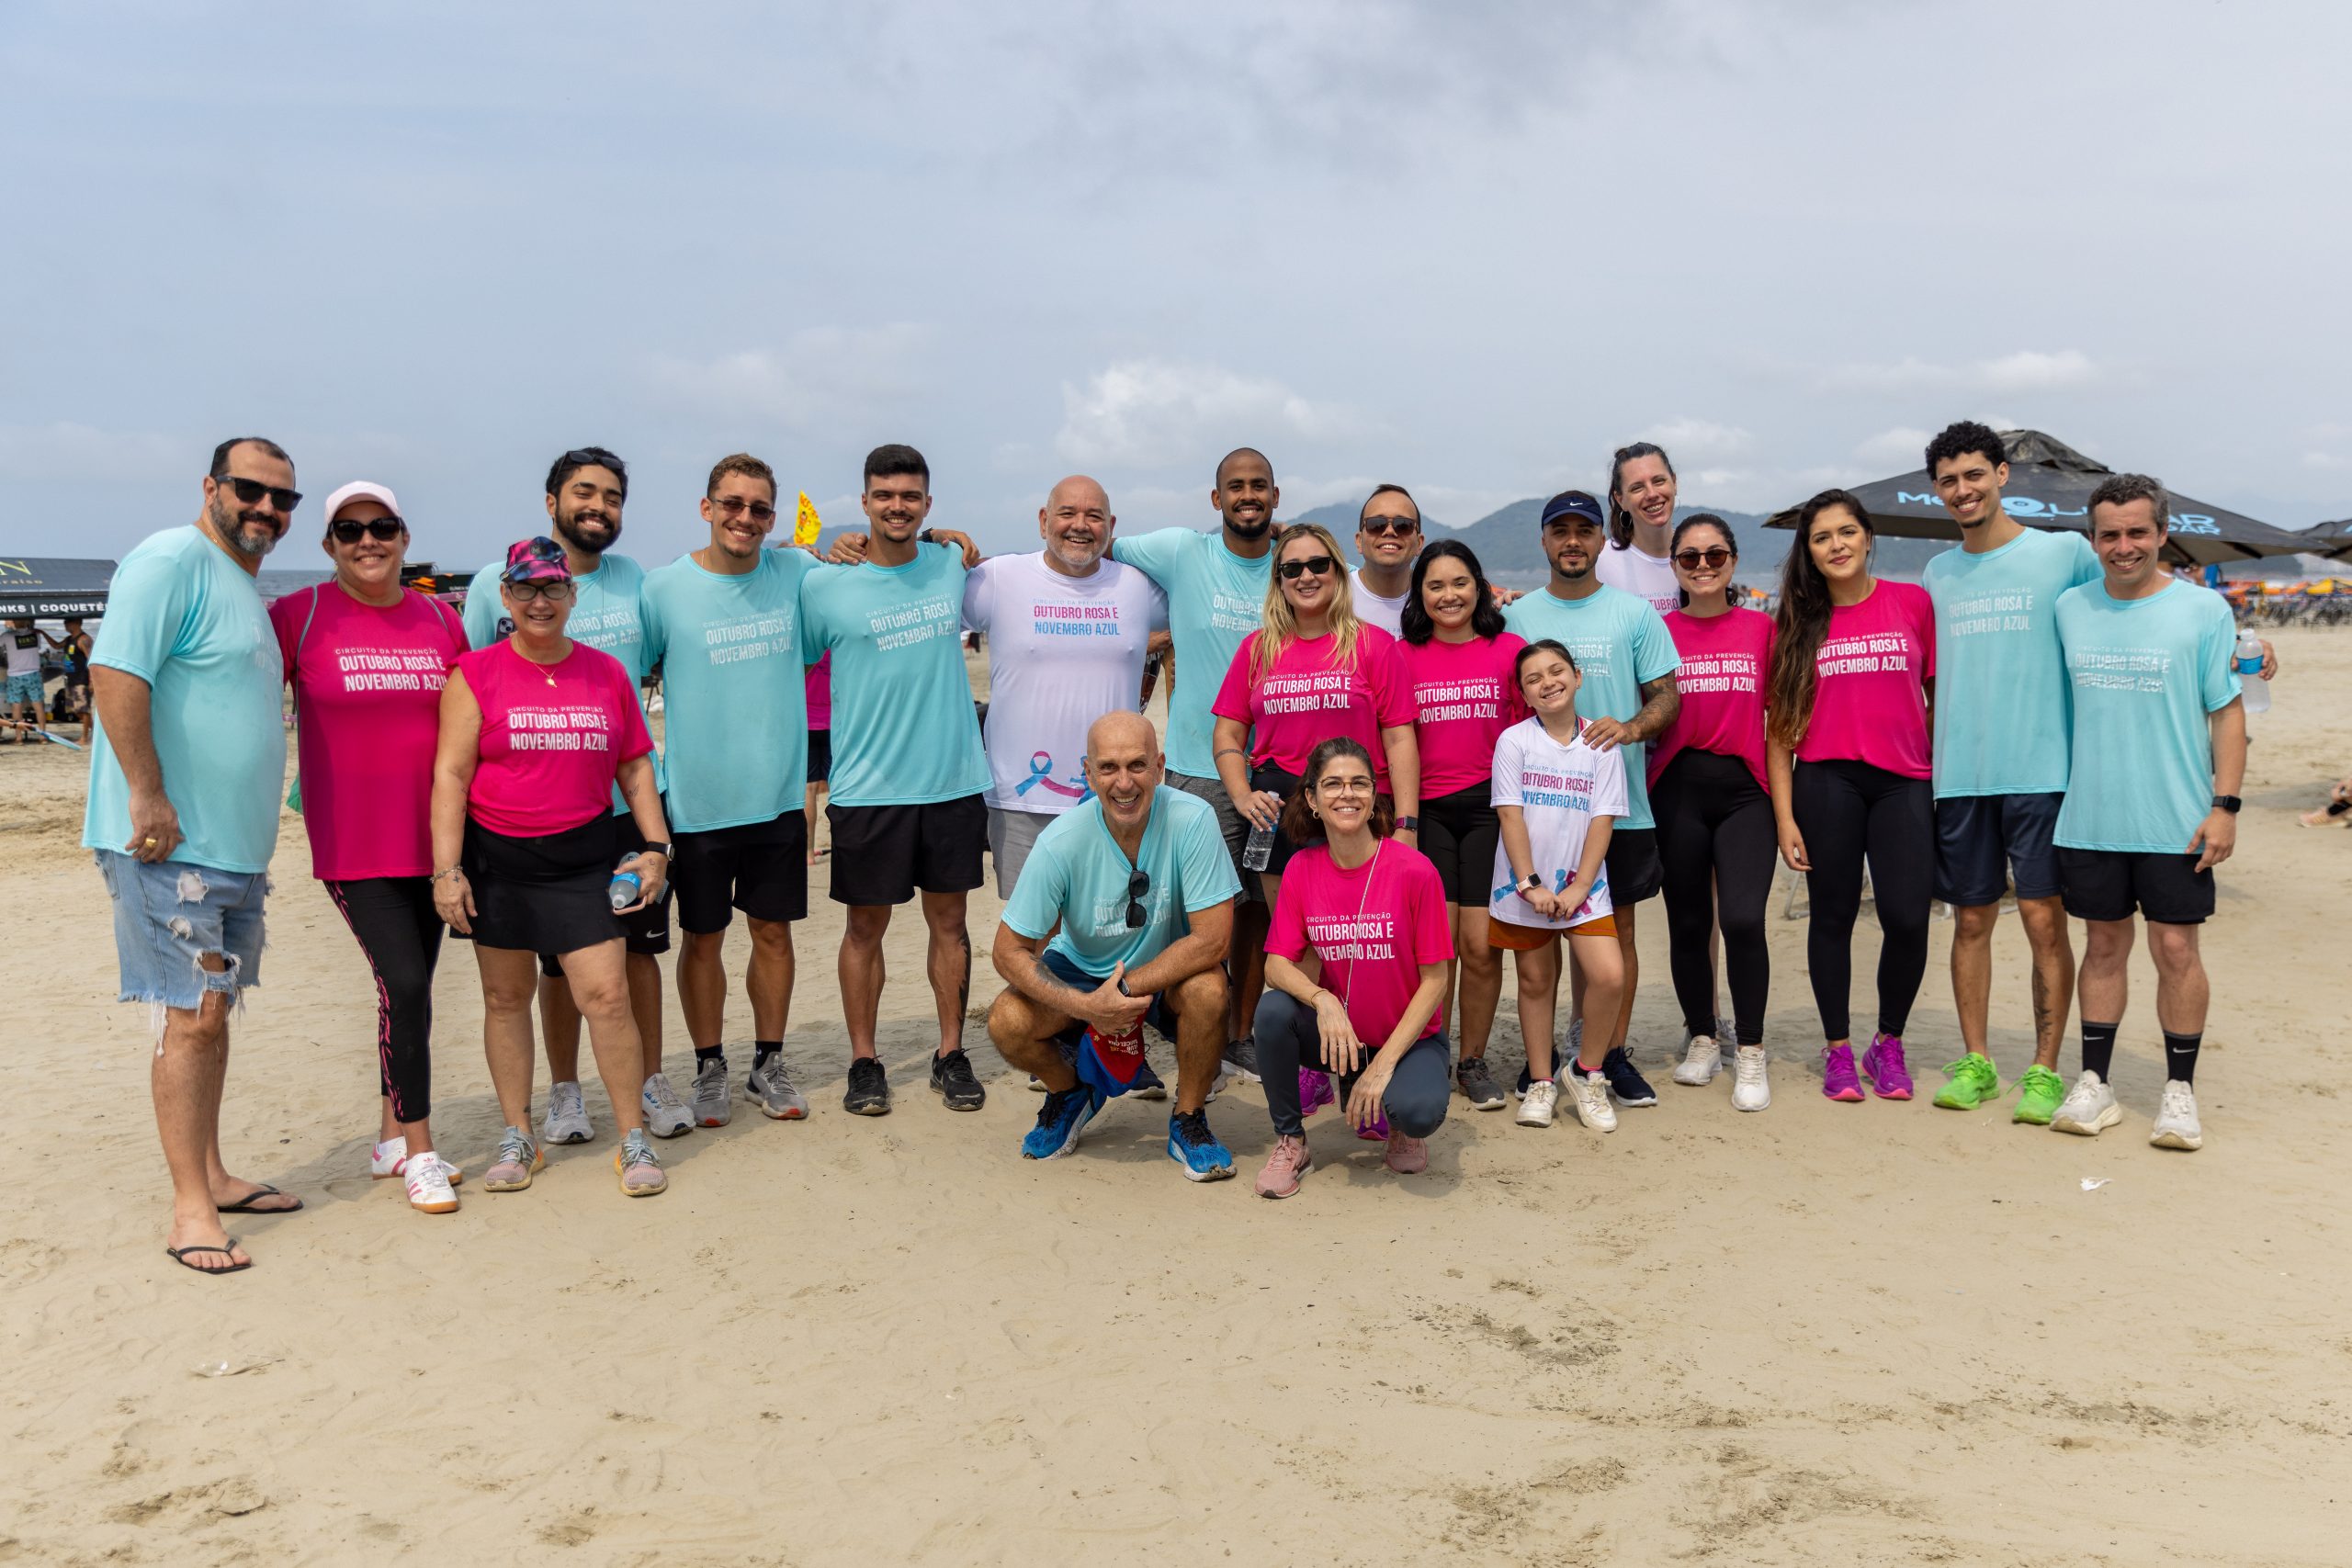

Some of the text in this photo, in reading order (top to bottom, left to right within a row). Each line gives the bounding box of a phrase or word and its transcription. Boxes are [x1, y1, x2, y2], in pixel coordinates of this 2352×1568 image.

[1034, 605, 1119, 618] OUTUBRO ROSA E
[1949, 595, 2033, 618] OUTUBRO ROSA E
[870, 608, 922, 633] OUTUBRO
[923, 602, 951, 620] ROSA
[1950, 615, 2031, 637] NOVEMBRO AZUL
[706, 624, 757, 645] OUTUBRO
[759, 618, 786, 637] ROSA
[1035, 622, 1121, 636] NOVEMBRO AZUL
[876, 625, 934, 652] NOVEMBRO
[709, 642, 769, 666] NOVEMBRO
[1577, 644, 1603, 659] ROSA
[1816, 638, 1908, 660] OUTUBRO ROSA E
[339, 655, 446, 671] OUTUBRO ROSA E
[1723, 660, 1749, 673] ROSA
[1751, 661, 1757, 675] E
[1818, 656, 1908, 678] NOVEMBRO AZUL
[345, 674, 420, 692] NOVEMBRO
[1310, 670, 1349, 678] PREVENÇÃO
[1263, 676, 1351, 696] OUTUBRO ROSA E
[1414, 682, 1444, 690] CIRCUITO
[1457, 677, 1498, 685] PREVENÇÃO
[1732, 677, 1756, 694] AZUL
[1415, 684, 1499, 705] OUTUBRO ROSA E
[1263, 694, 1351, 716] NOVEMBRO AZUL
[1474, 703, 1498, 718] AZUL
[509, 713, 609, 730] OUTUBRO ROSA E
[510, 733, 608, 751] NOVEMBRO AZUL
[1565, 777, 1588, 793] ROSA
[1589, 781, 1594, 795] E
[1386, 922, 1394, 938] E
[1367, 943, 1395, 960] AZUL
